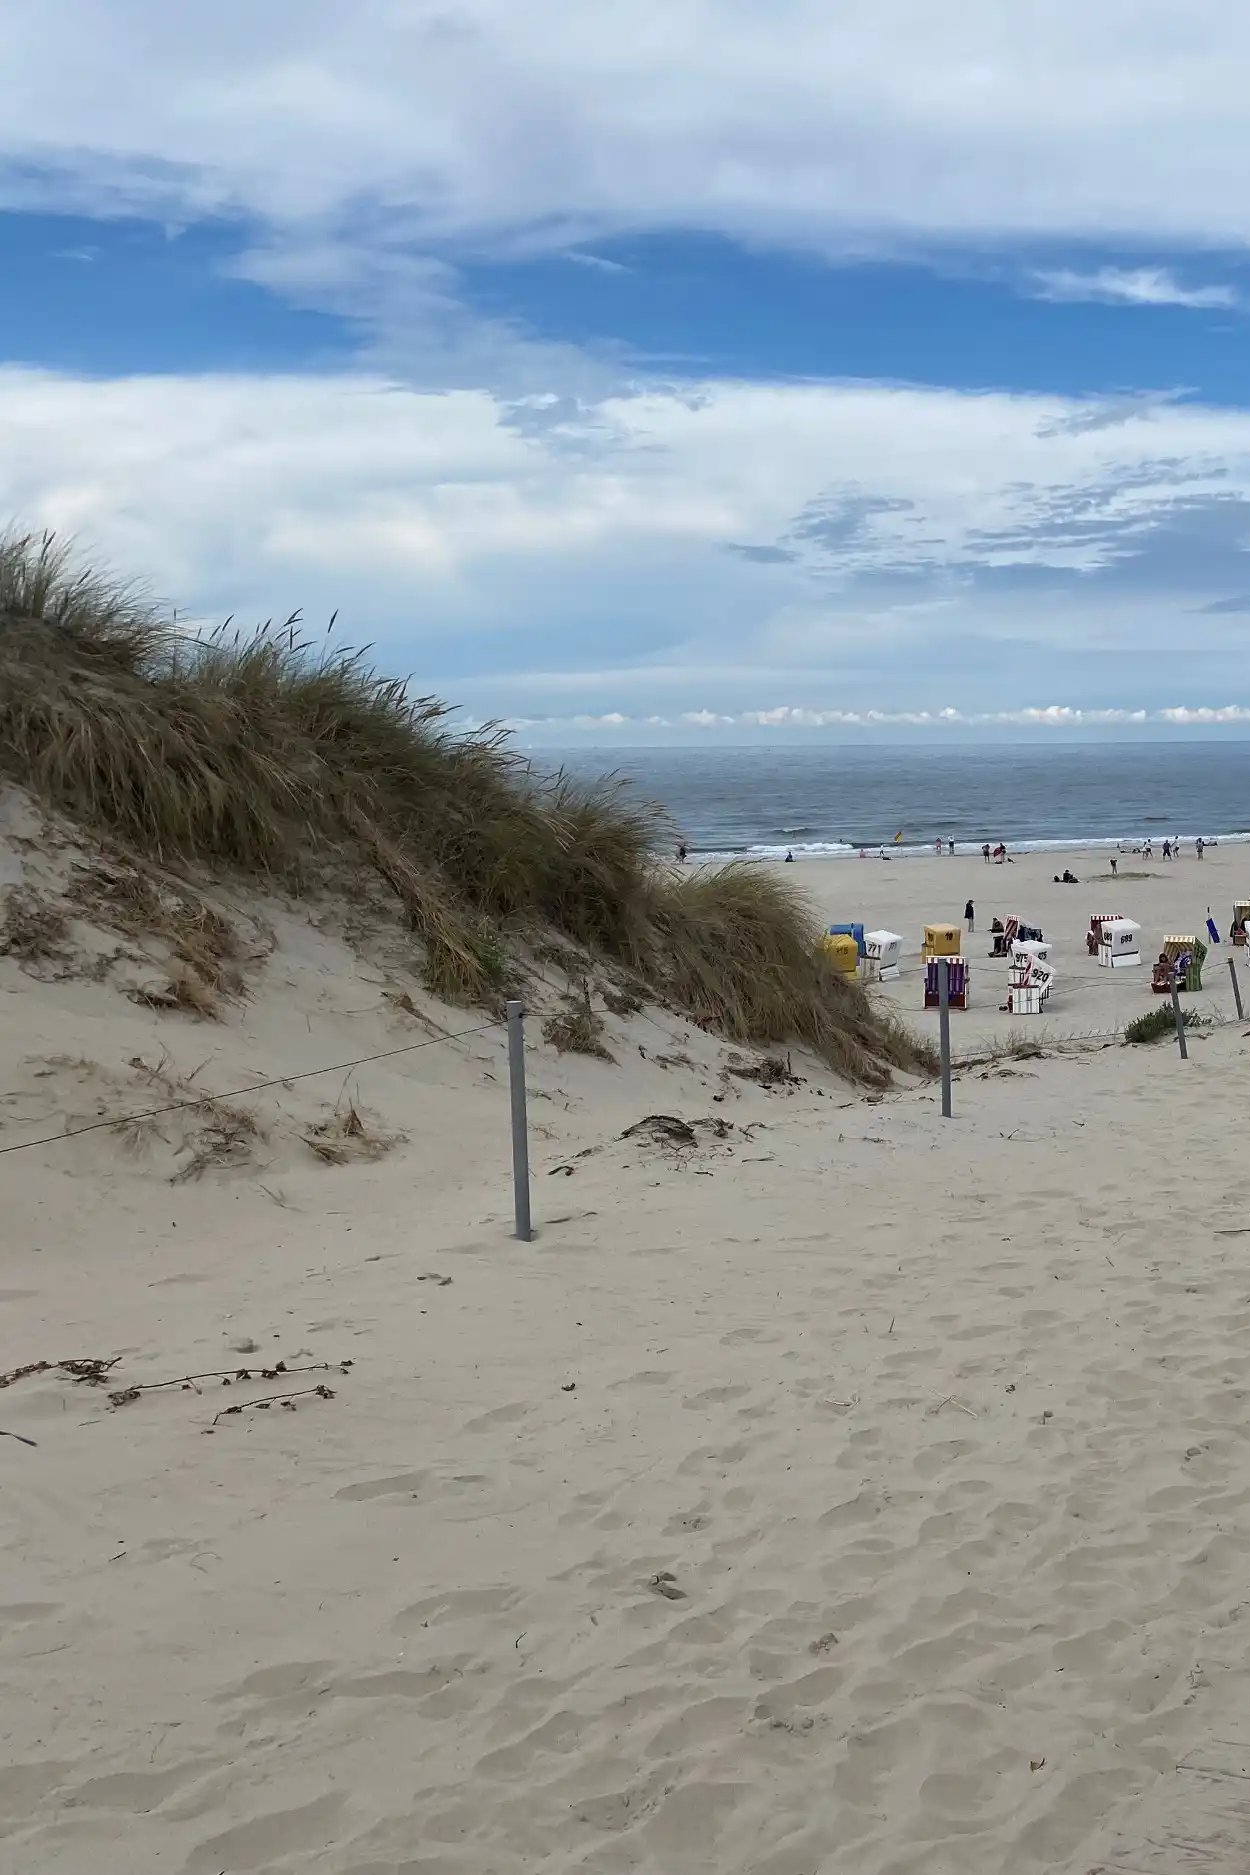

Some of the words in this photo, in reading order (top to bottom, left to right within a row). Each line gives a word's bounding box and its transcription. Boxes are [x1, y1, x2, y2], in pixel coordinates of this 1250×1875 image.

[1120, 933, 1133, 944] 689
[867, 943, 882, 954] 771
[1031, 967, 1050, 983] 920
